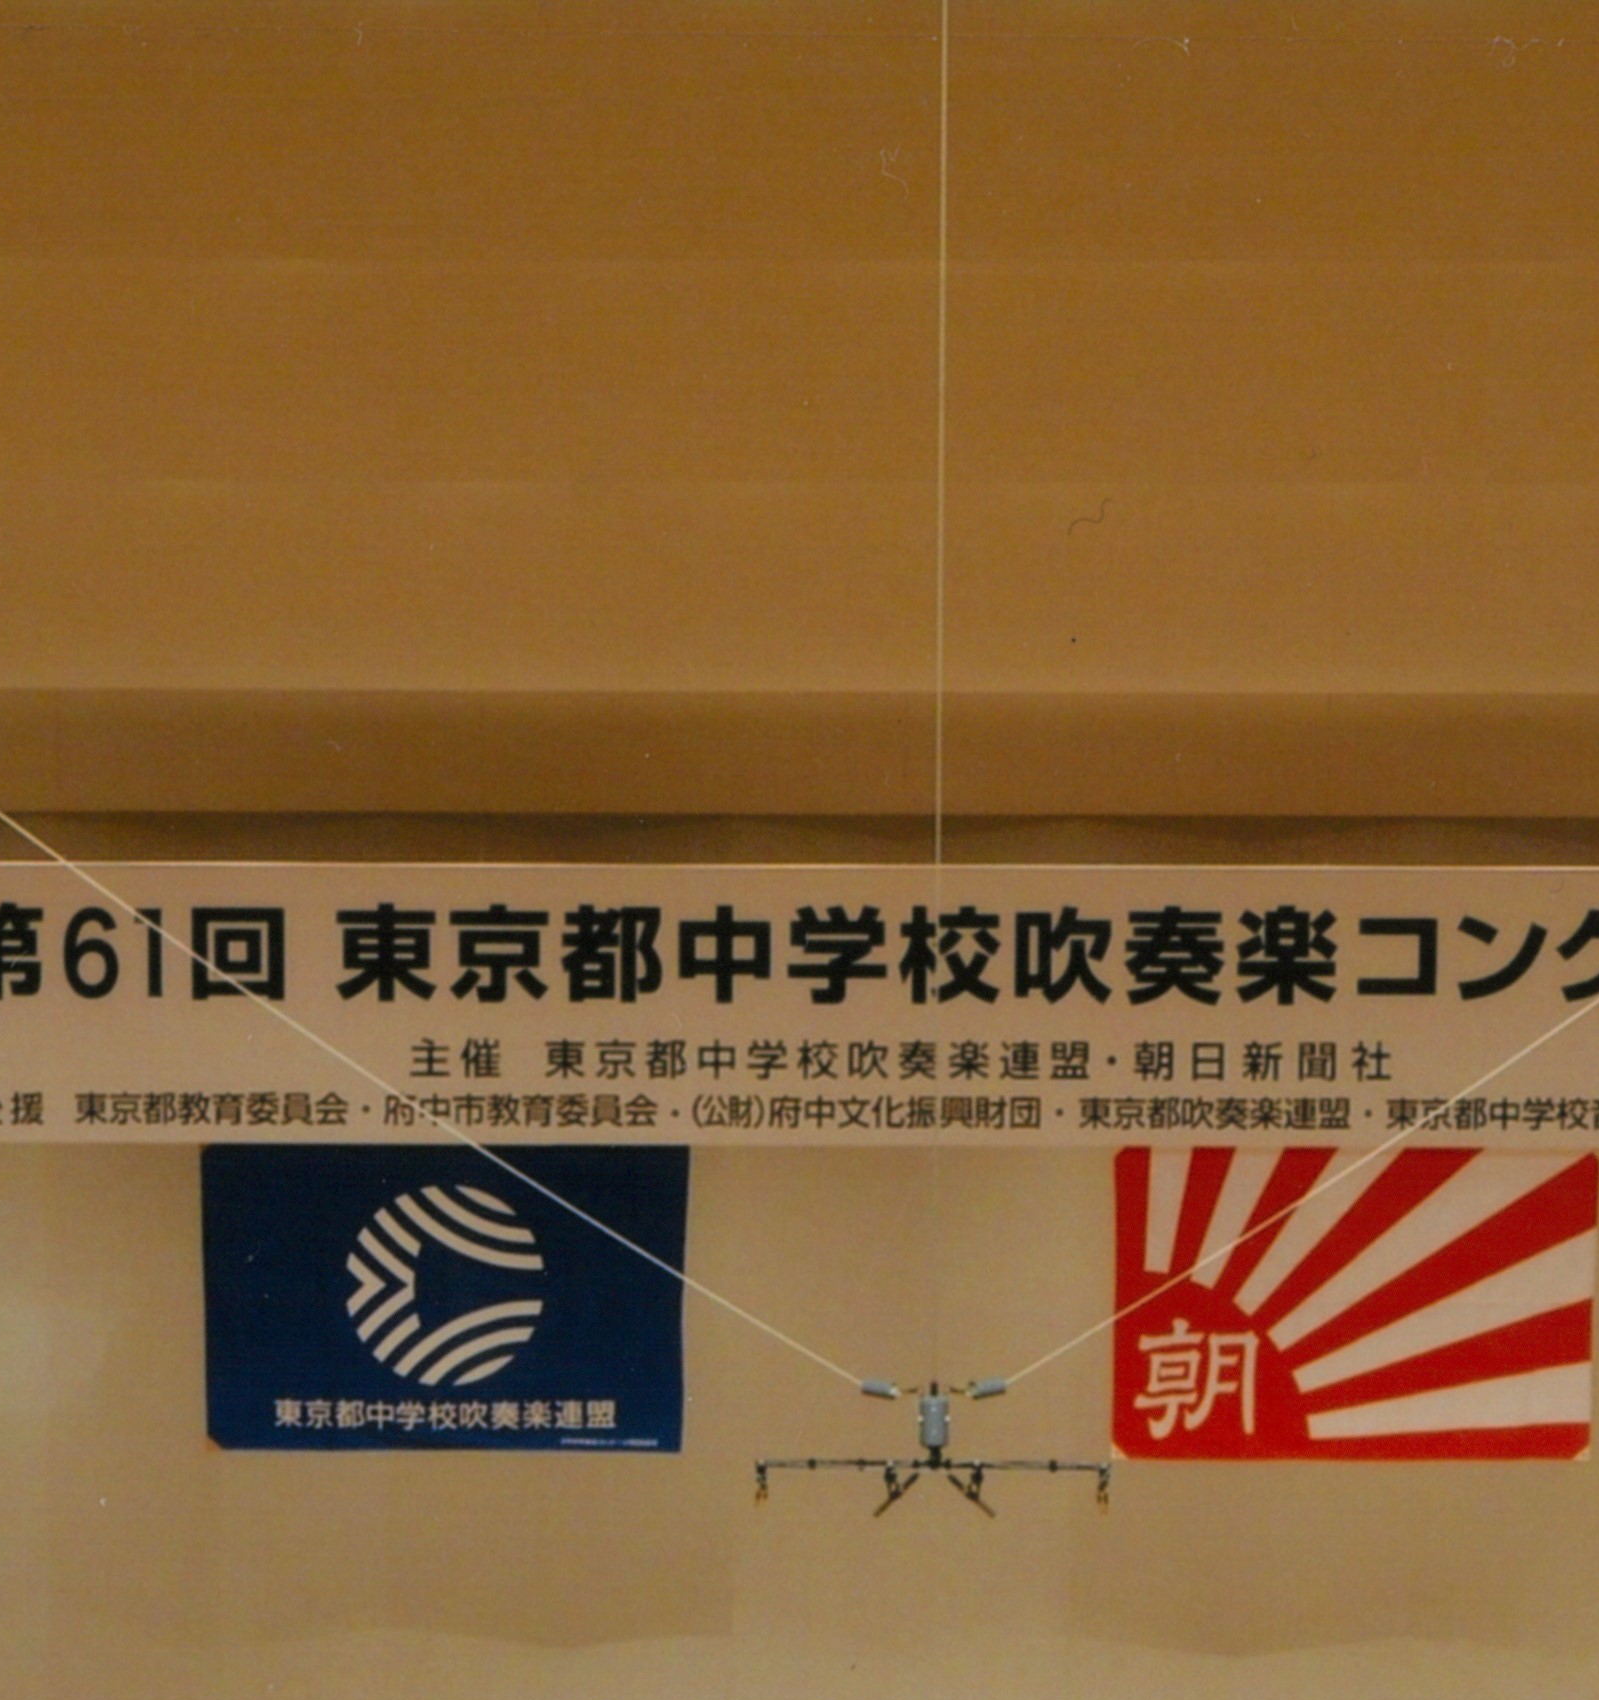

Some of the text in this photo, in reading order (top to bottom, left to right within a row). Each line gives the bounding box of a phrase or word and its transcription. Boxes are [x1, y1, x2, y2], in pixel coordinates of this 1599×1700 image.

[409, 1037, 502, 1080] 主催
[1133, 1317, 1260, 1440] 朝
[274, 1398, 616, 1431] 東京都中学校吹奏楽連盟
